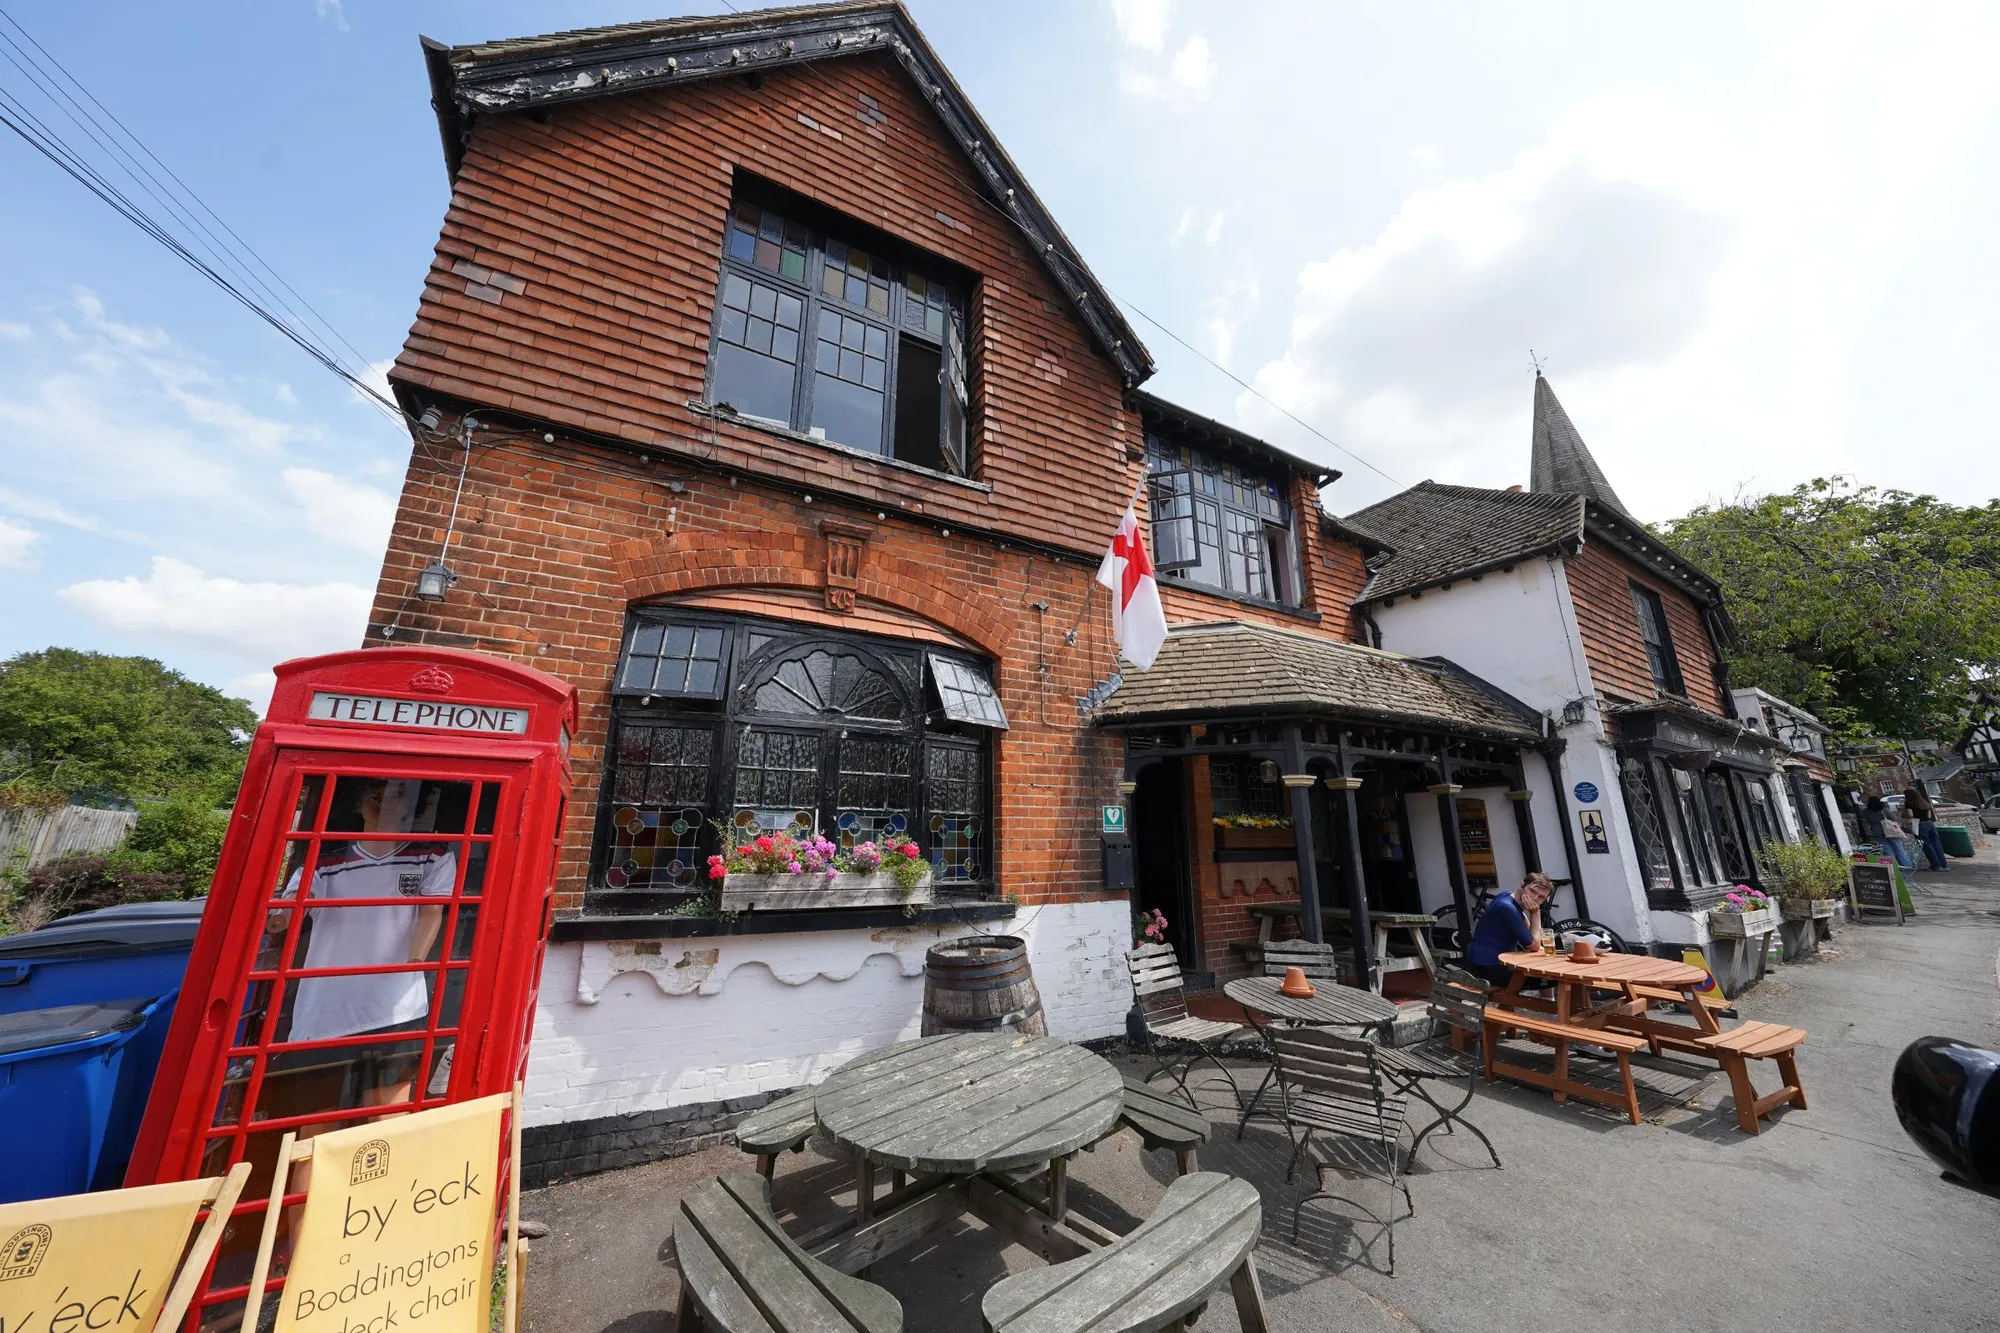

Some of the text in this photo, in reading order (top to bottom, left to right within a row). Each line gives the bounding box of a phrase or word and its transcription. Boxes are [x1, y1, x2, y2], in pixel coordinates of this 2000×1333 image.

[327, 696, 518, 732] TELEPHONE
[354, 1141, 388, 1164] BODDINGTONS
[353, 1169, 385, 1183] BITTER
[343, 1196, 397, 1242] by
[3, 1226, 50, 1253] BODDINGTONS
[339, 1252, 351, 1265] a
[0, 1266, 35, 1279] ITTER
[295, 1240, 478, 1321] Boddingtons
[409, 1278, 476, 1319] chair
